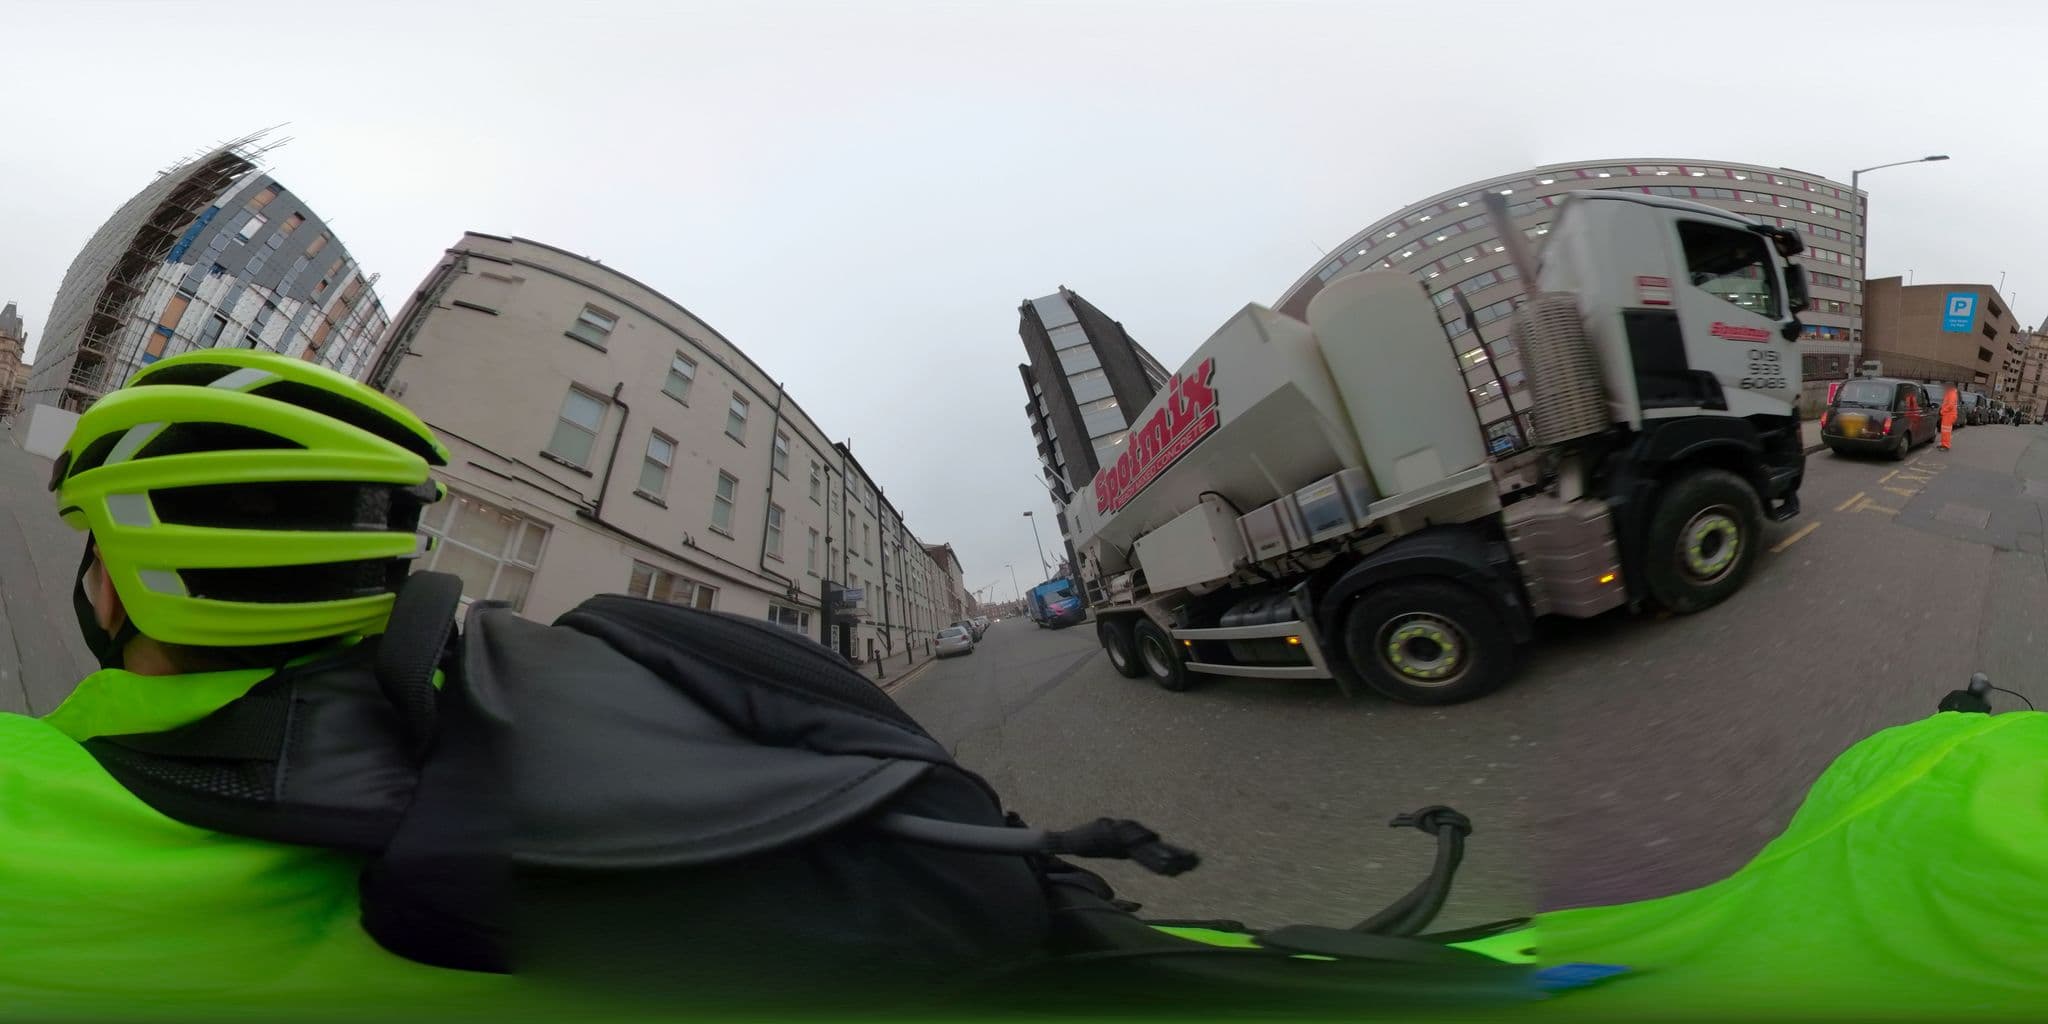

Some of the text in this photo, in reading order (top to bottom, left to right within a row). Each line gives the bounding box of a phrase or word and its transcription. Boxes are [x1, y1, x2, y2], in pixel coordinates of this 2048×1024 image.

[1954, 300, 1967, 313] P
[1094, 358, 1216, 513] Spotmix
[1157, 417, 1208, 469] CONCRETE
